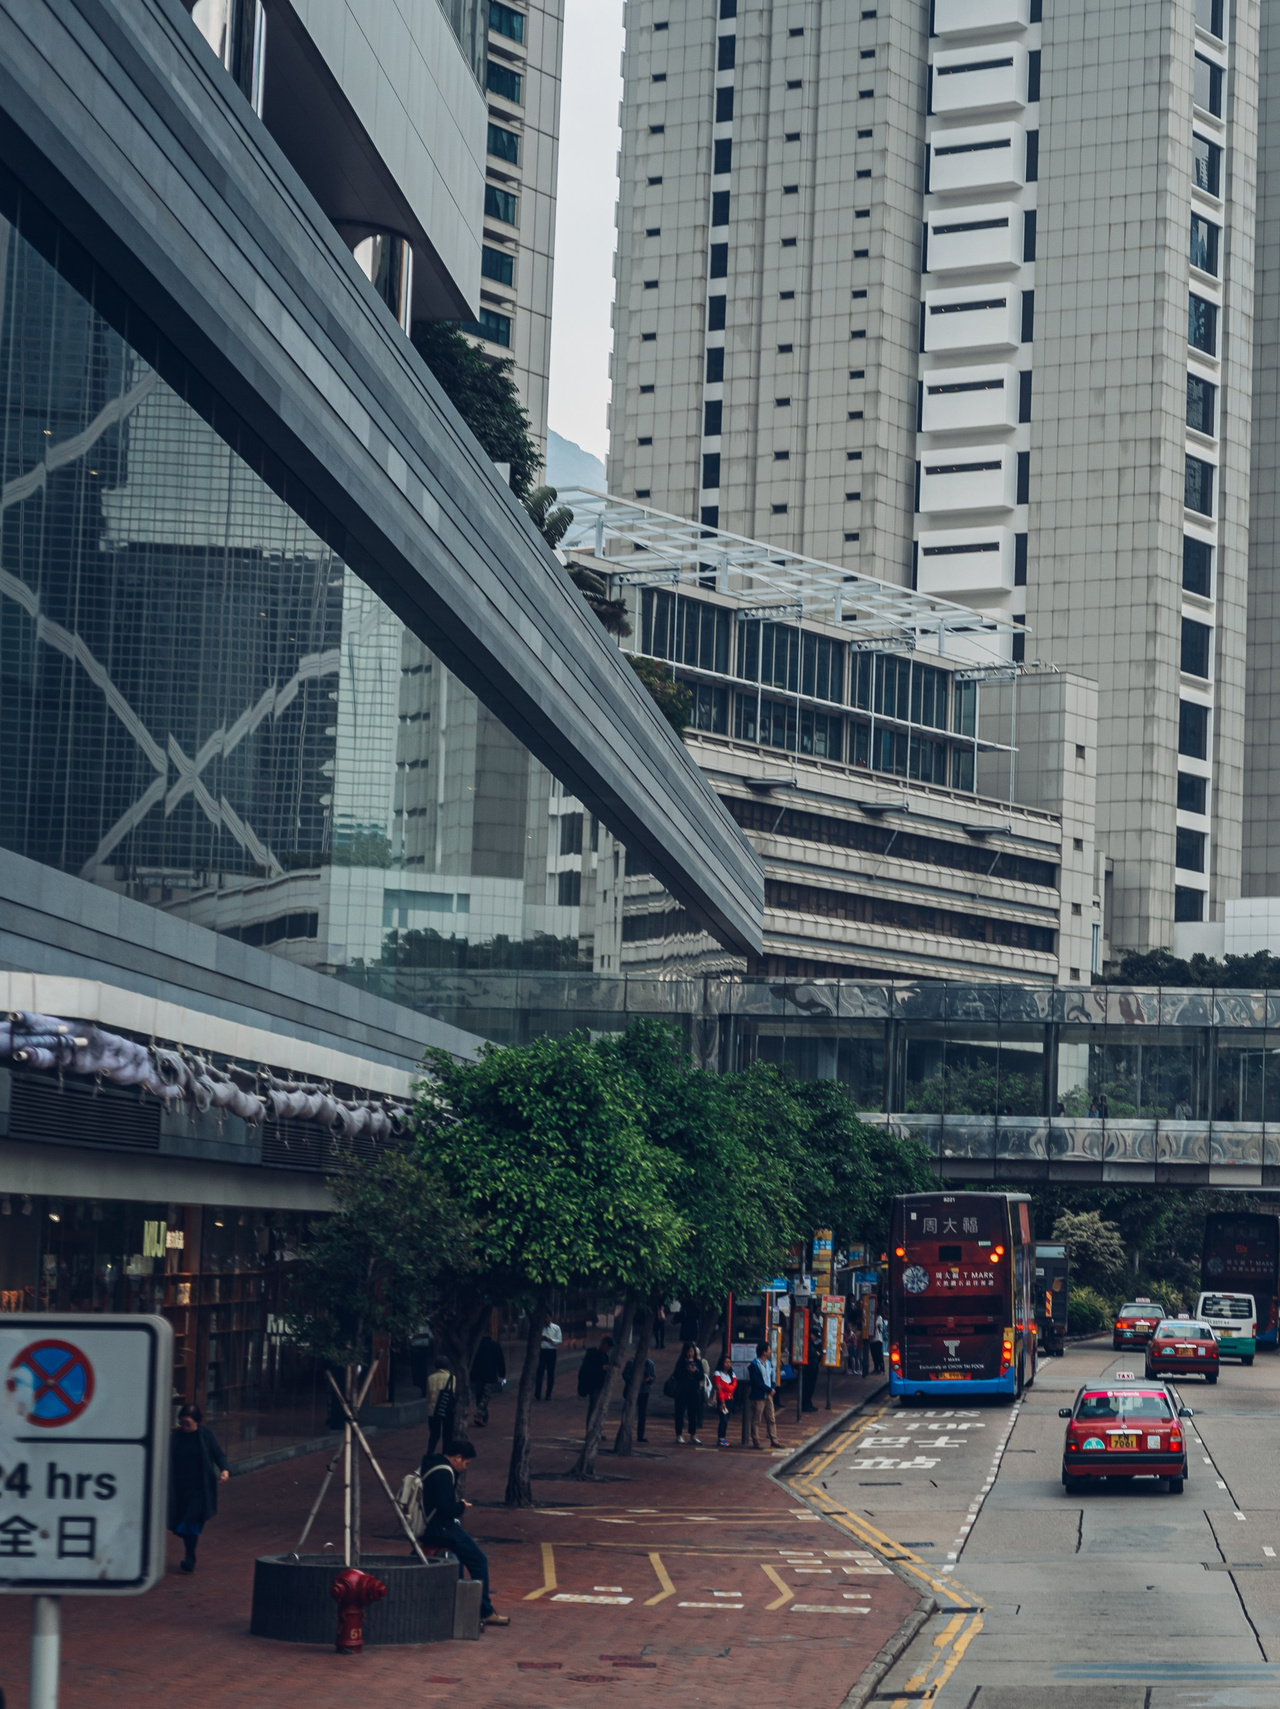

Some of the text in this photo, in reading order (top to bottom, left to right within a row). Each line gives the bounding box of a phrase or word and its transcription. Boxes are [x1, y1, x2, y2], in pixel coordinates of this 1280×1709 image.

[922, 1216, 979, 1234] 周大福
[963, 1271, 968, 1279] T
[971, 1271, 994, 1279] MARK
[856, 1435, 968, 1449] 巴士
[0, 1461, 118, 1501] 4 hrs
[0, 1514, 97, 1560] 全日
